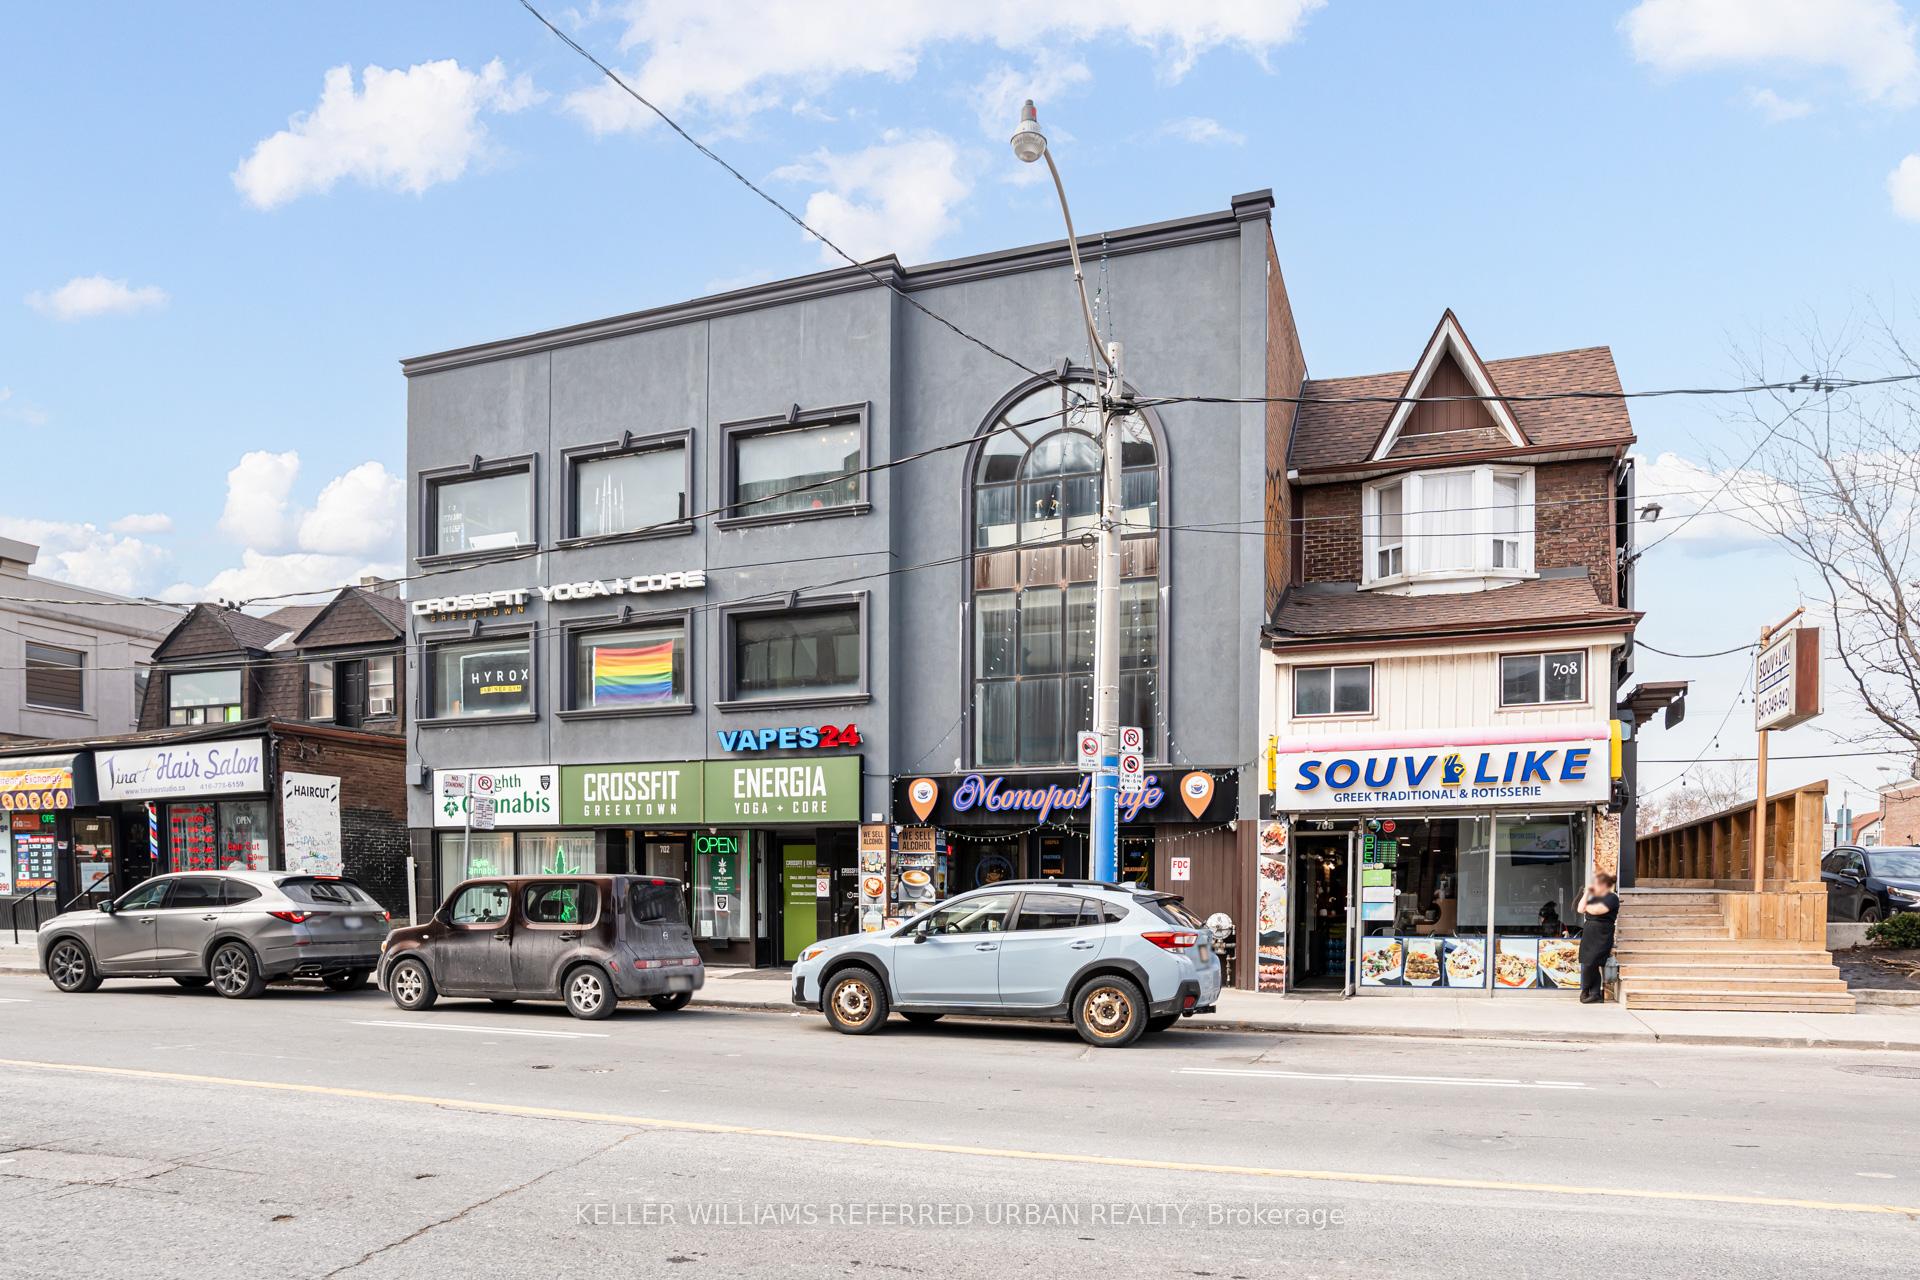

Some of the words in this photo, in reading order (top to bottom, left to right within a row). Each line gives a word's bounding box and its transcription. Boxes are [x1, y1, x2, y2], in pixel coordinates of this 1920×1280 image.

[538, 580, 611, 602] YOGA
[629, 570, 706, 594] CORE
[412, 588, 529, 615] CROSSFIT
[430, 606, 525, 623] GREEKTOWN
[471, 668, 529, 684] HYROX
[1552, 660, 1578, 676] 708
[717, 723, 864, 752] VAPES24
[156, 751, 200, 780] Hair
[204, 748, 259, 779] Salon
[1294, 755, 1438, 791] SOUV
[1474, 748, 1592, 785] LIKE
[494, 774, 521, 792] ghth
[583, 770, 681, 801] CROSSFIT
[734, 766, 827, 798] ENERGIA
[294, 785, 330, 798] HAIRCUT
[953, 774, 1093, 823] Monopol
[1118, 775, 1164, 822] afe
[1334, 791, 1371, 803] GREEK
[1375, 789, 1456, 802] TRADITIONAL
[1459, 789, 1468, 799] &
[1471, 786, 1542, 799] ROTISSERIE
[584, 803, 678, 817] GREEKTOWN
[734, 802, 769, 815] YOGA
[792, 800, 827, 814] CORE
[235, 816, 251, 825] OPEN
[903, 831, 912, 840] WE
[914, 830, 931, 840] SELL
[660, 845, 670, 853] 702
[697, 837, 738, 853] OPEN
[903, 840, 932, 851] ALCOHOL
[1172, 860, 1188, 869] FDC
